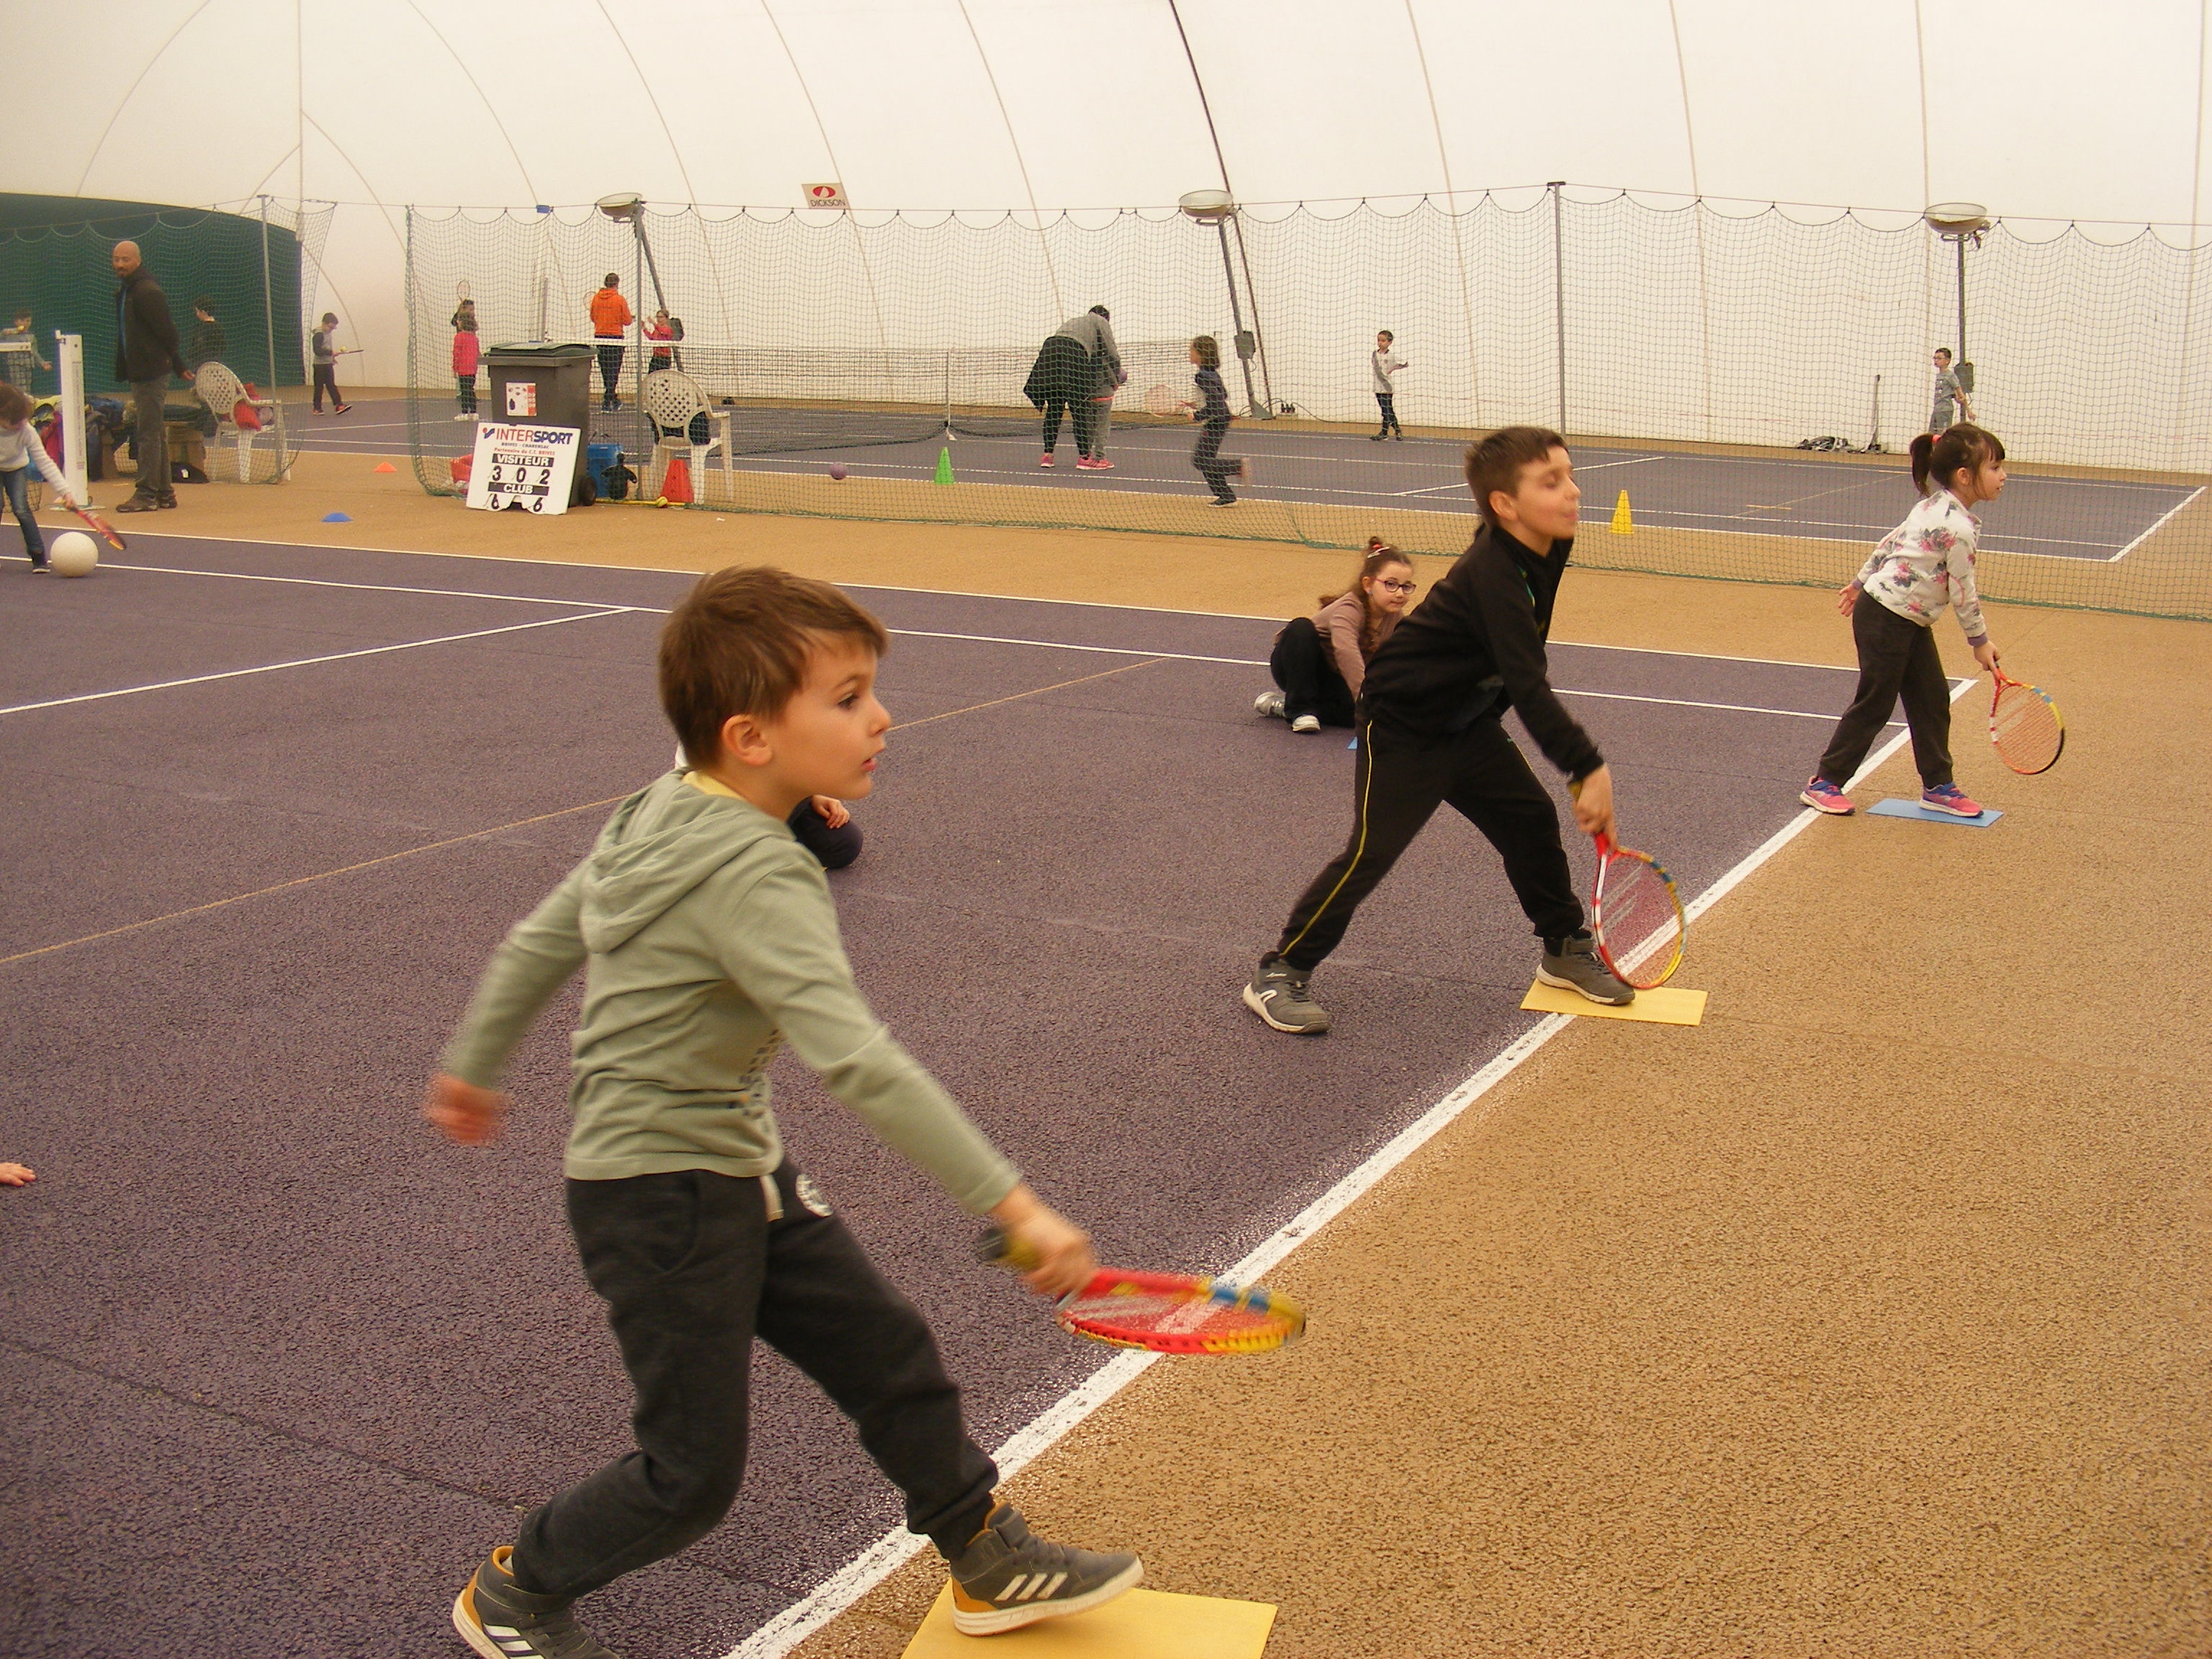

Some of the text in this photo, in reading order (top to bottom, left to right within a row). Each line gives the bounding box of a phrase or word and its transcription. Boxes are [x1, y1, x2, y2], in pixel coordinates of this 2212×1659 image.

[496, 428, 573, 444] INTERSPORT
[497, 454, 549, 466] VISITEUR
[492, 466, 551, 485] 3 0 2
[503, 483, 534, 495] CLUB
[492, 494, 543, 513] 6 6
